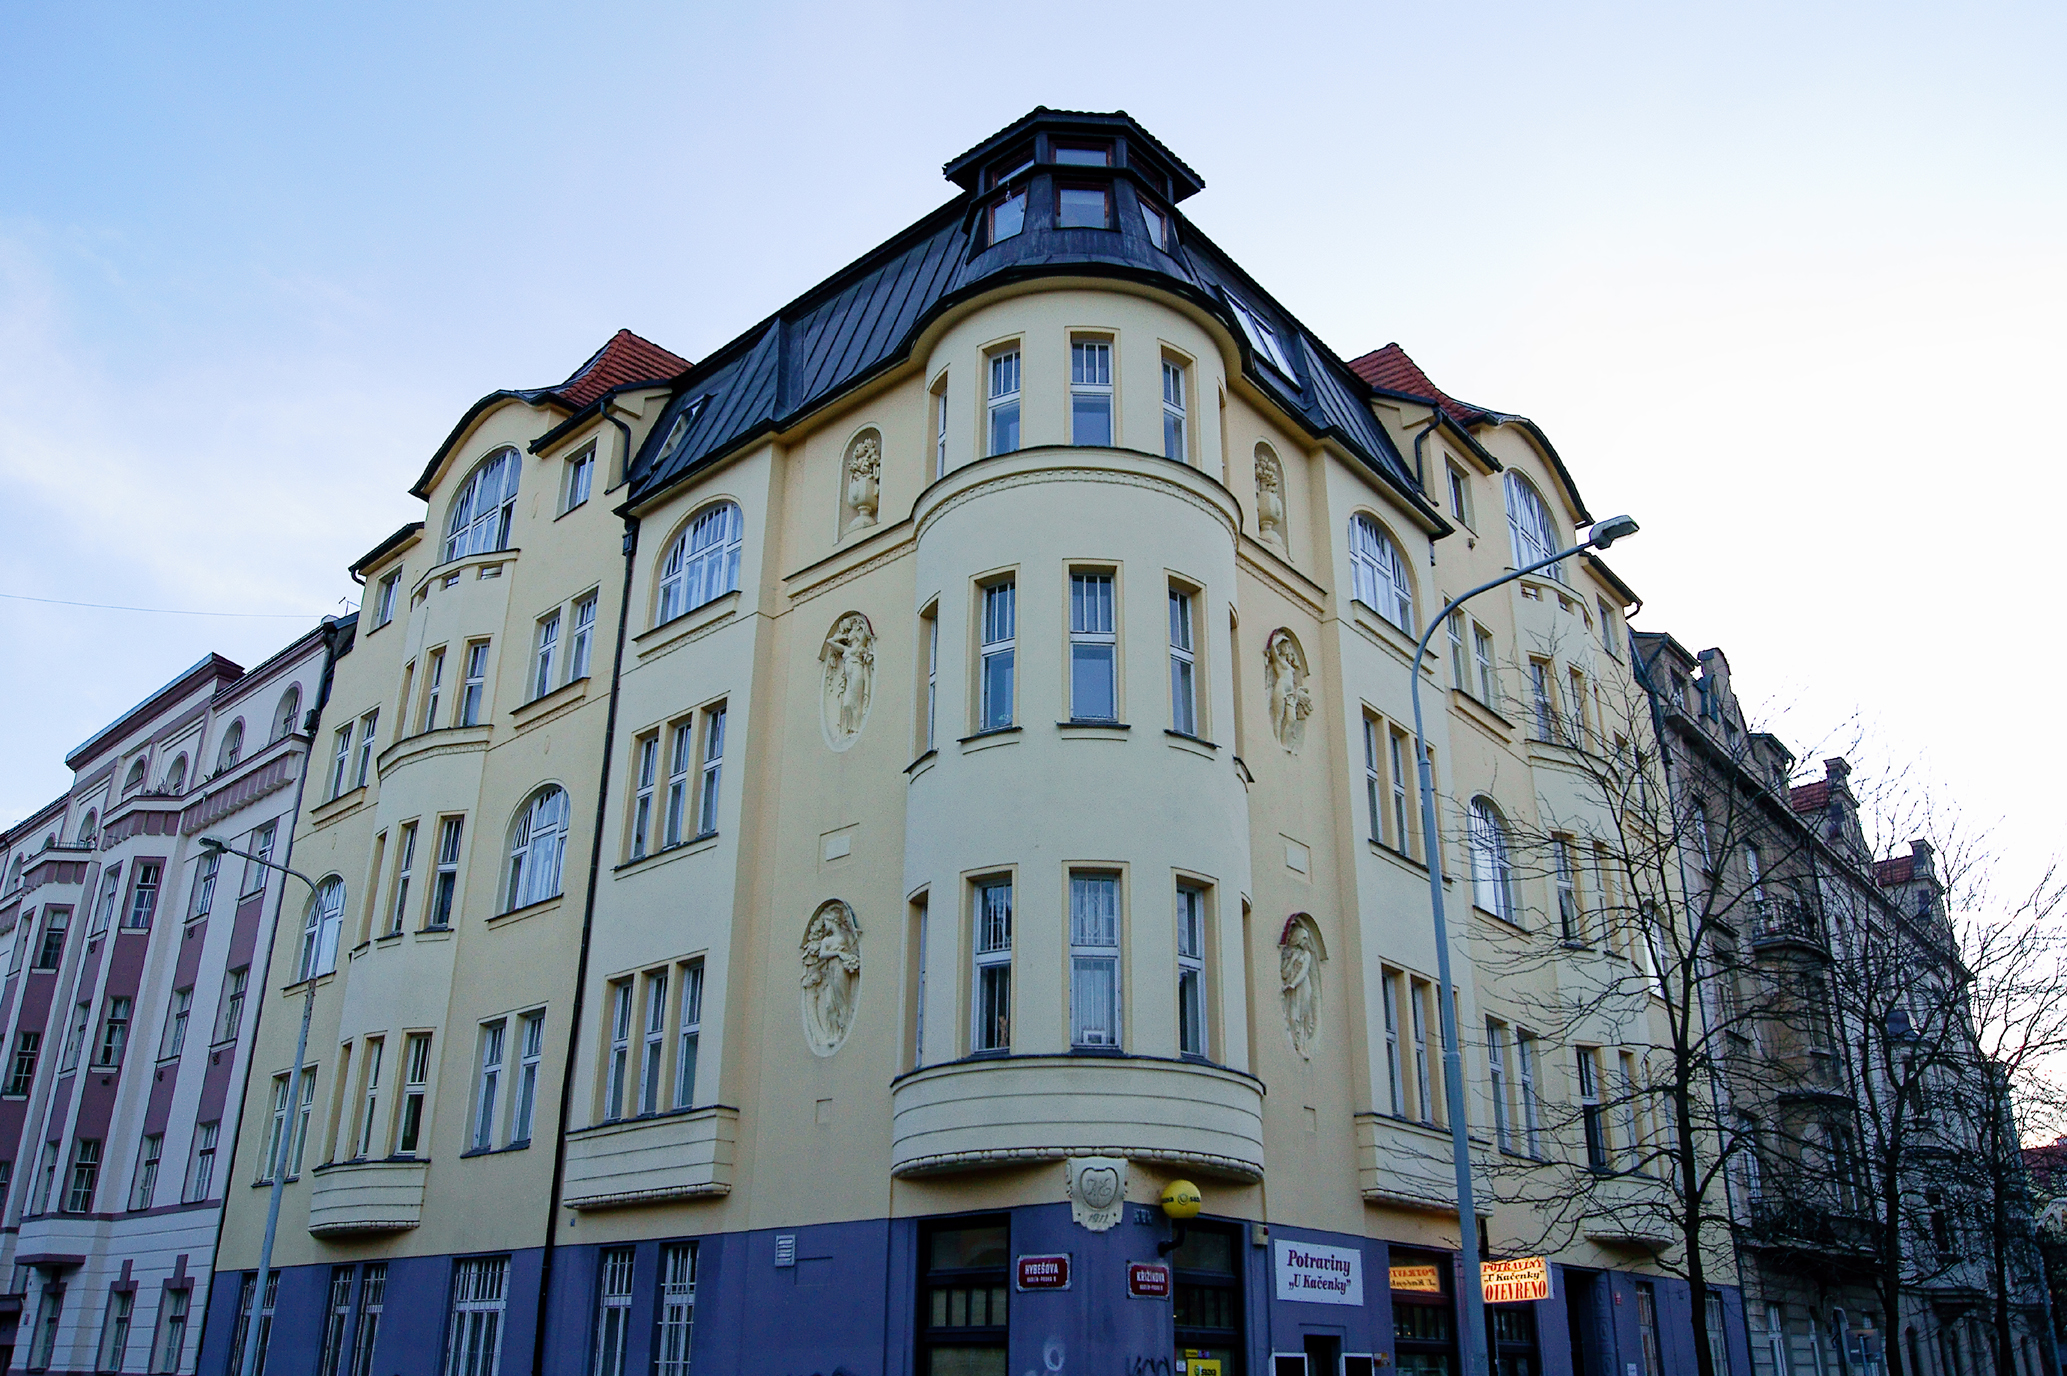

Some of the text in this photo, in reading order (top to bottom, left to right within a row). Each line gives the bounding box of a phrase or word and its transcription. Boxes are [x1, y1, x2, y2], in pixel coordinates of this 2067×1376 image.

[1024, 1262, 1059, 1275] HYBEŠOVA
[1287, 1249, 1351, 1277] Potraviny
[1483, 1258, 1543, 1273] POTRAVINY
[1485, 1280, 1547, 1301] OTEVŘENO
